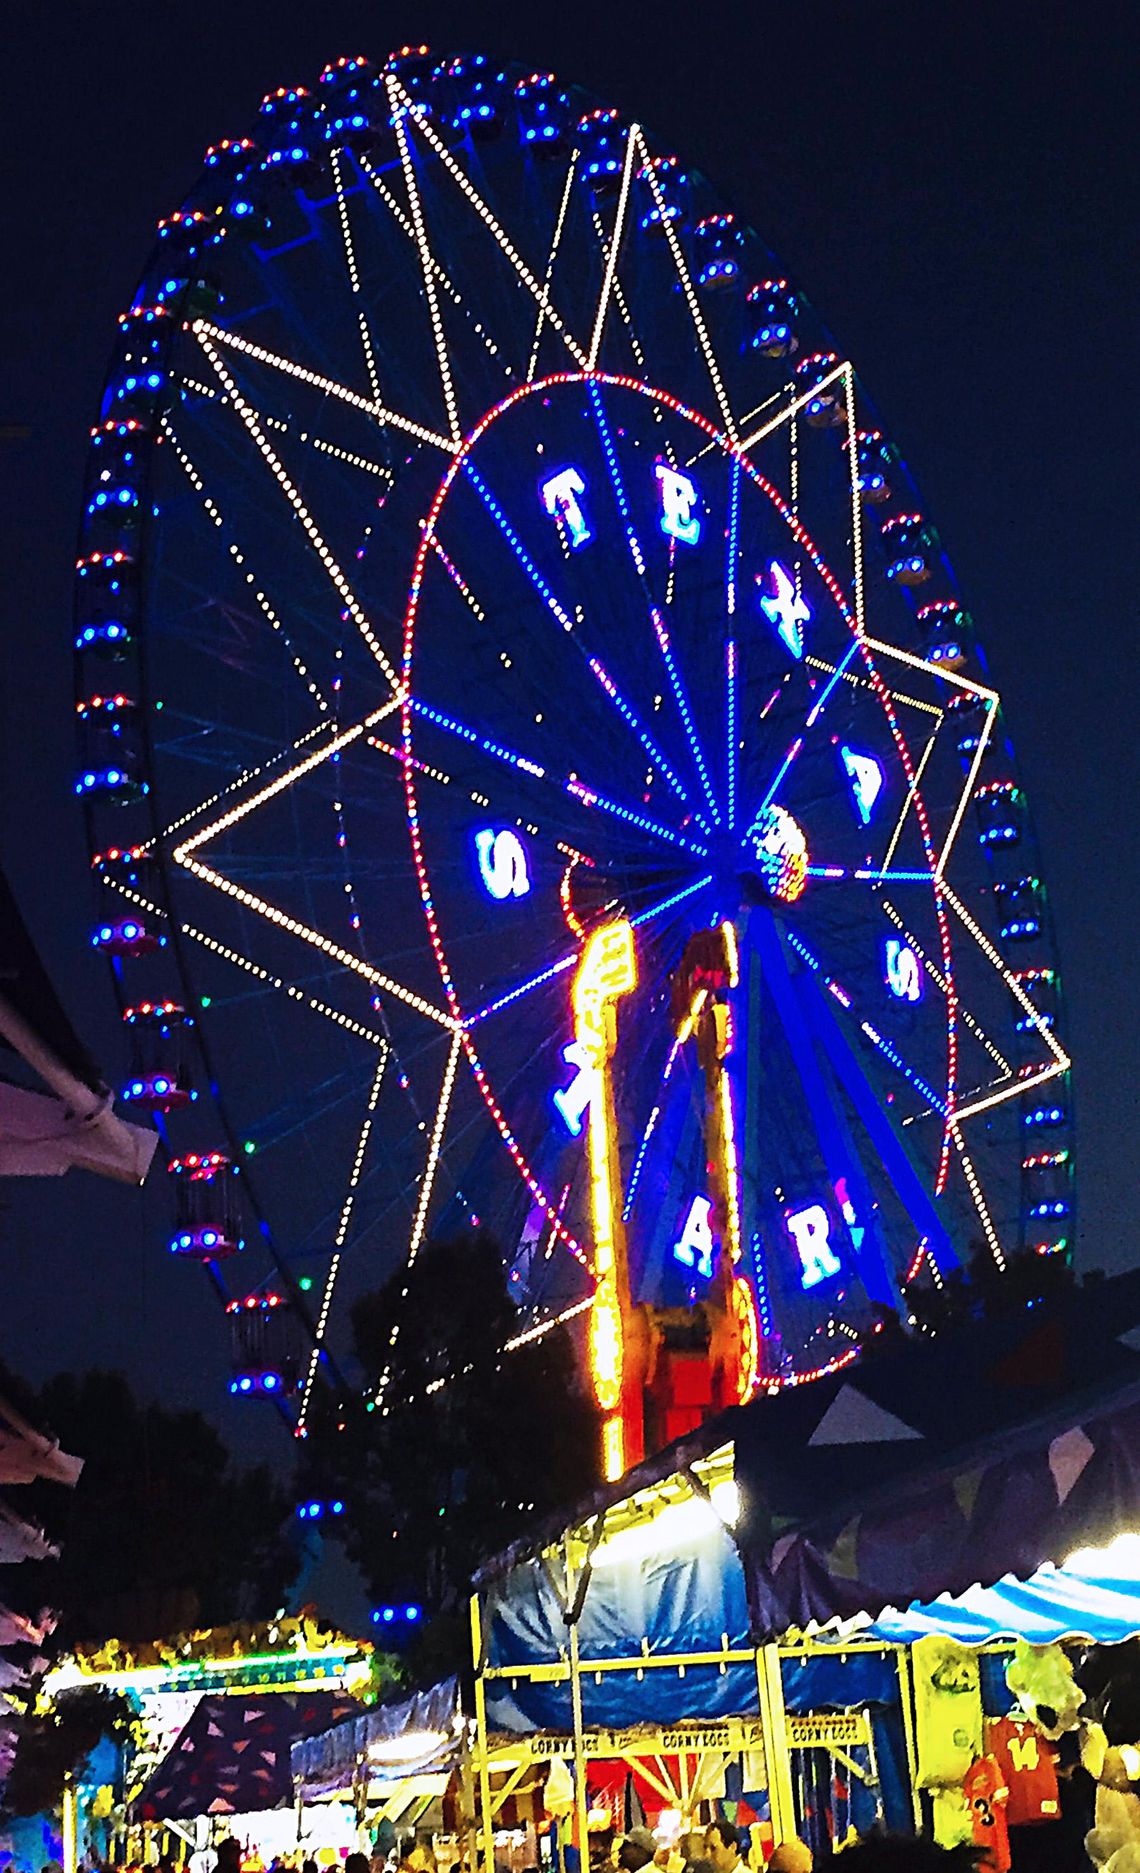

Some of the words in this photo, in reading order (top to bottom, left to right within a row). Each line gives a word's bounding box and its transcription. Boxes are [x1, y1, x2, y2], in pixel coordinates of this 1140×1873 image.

[540, 465, 921, 1002] TEXAS
[476, 828, 843, 1287] STAR
[662, 1734, 700, 1748] CORNY
[792, 1727, 829, 1742] CORNY
